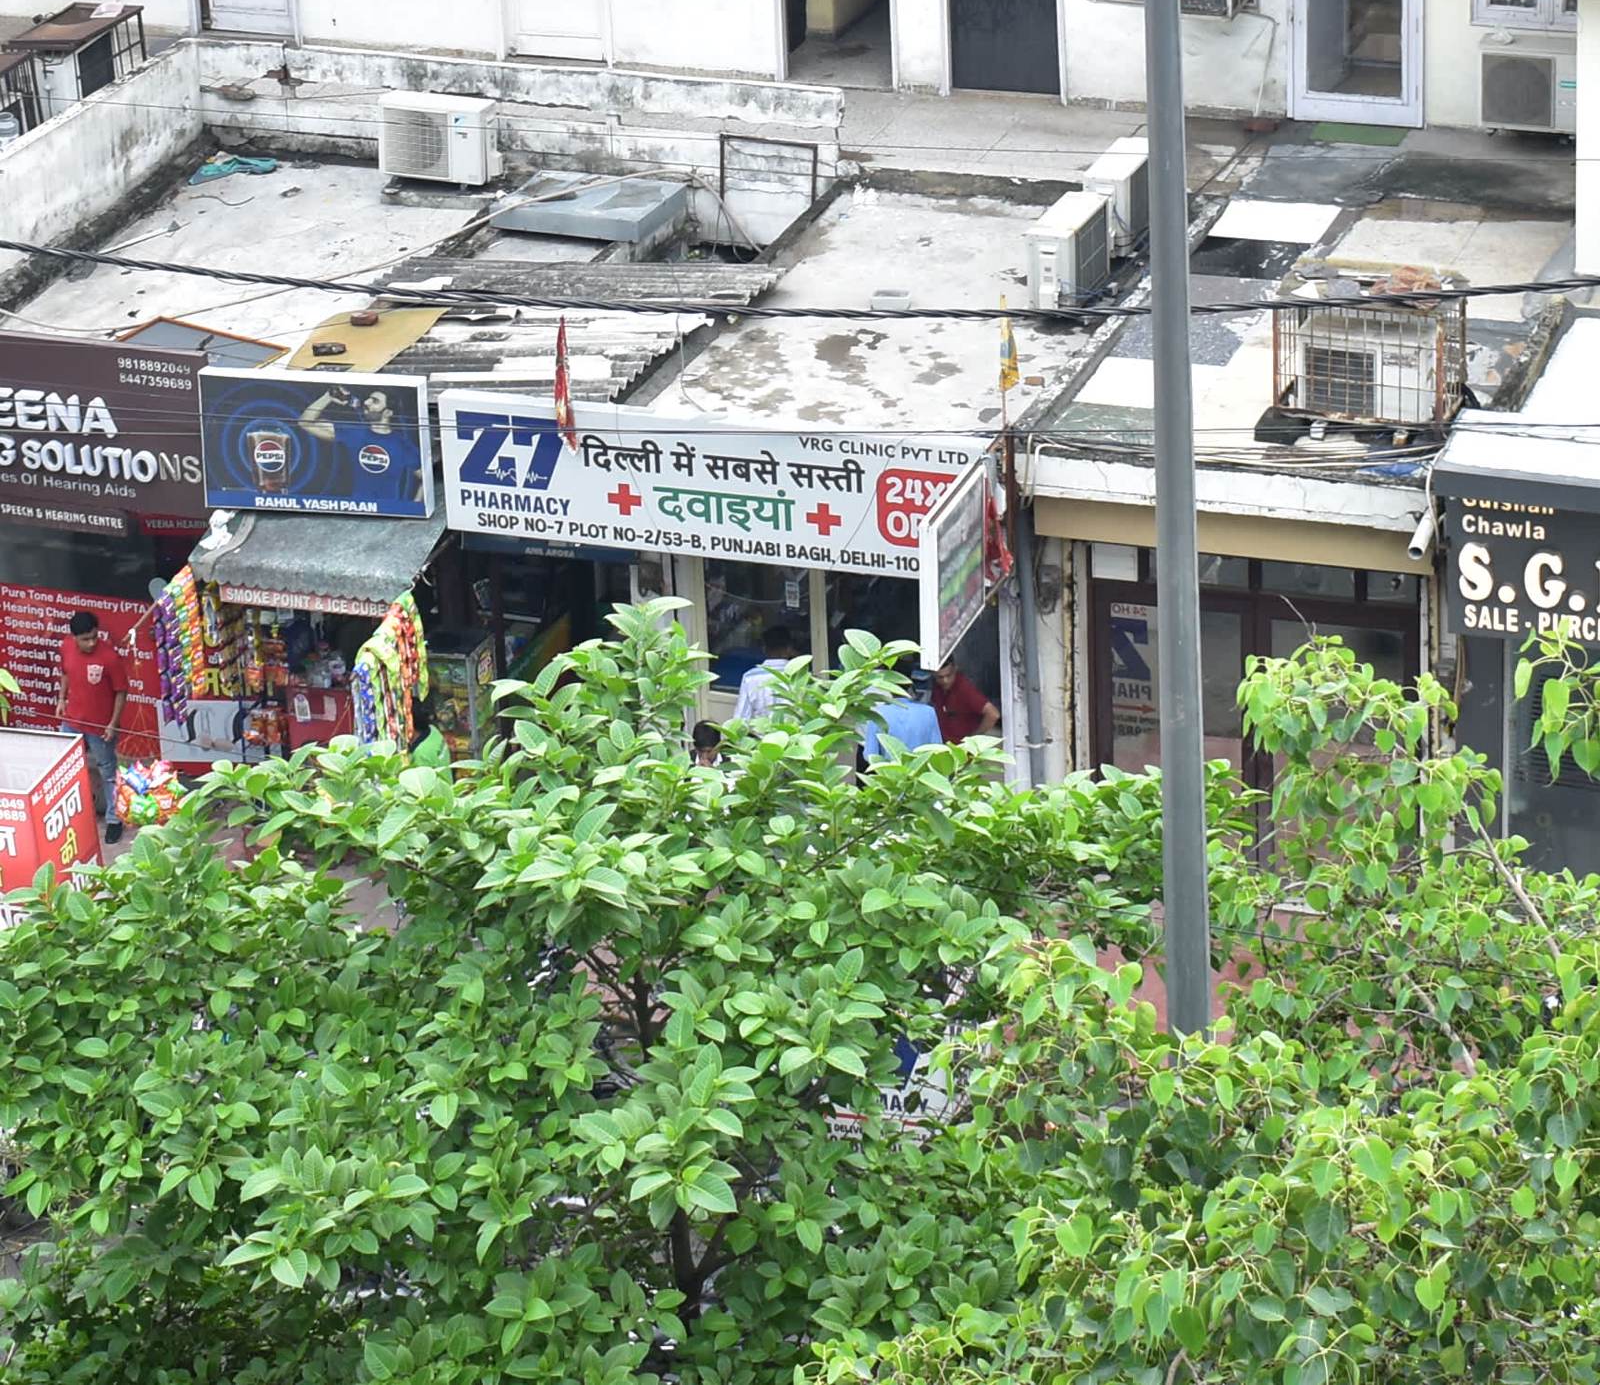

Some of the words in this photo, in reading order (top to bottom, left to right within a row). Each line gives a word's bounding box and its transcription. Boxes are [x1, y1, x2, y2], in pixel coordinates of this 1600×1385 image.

[117, 357, 191, 375] 9818892049
[119, 372, 193, 391] 8447359689
[20, 438, 202, 484] SOLUTIONS
[256, 452, 284, 460] PEPSI
[580, 434, 663, 474] दिल्ली
[669, 442, 696, 478] में
[702, 449, 781, 486] सबसे
[787, 456, 865, 494] सस्ती
[799, 436, 834, 453] VRG
[838, 439, 897, 459] CLINIC
[901, 446, 933, 462] PVT
[938, 449, 970, 466] LTD
[21, 473, 38, 486] Of
[43, 476, 101, 496] Hearing
[104, 482, 137, 498] Aids
[885, 476, 951, 507] 24X
[255, 496, 300, 509] RAHUL
[302, 498, 339, 511] YASH
[340, 500, 378, 513] PAAN
[460, 488, 571, 517] PHARMACY
[652, 486, 797, 533] दवाइयां
[0, 503, 34, 518] SPEECH
[45, 508, 87, 525] HEARING
[88, 512, 124, 530] CENTRE
[1462, 513, 1546, 541] Chawla
[477, 512, 520, 531] SHOP
[524, 516, 563, 535] NO-7
[569, 521, 608, 541] PLOT
[711, 537, 781, 558] PUNJABI
[1459, 541, 1600, 613] S.G.
[1, 585, 27, 599] Pure
[28, 588, 54, 603] Tone
[56, 593, 119, 613] Audiometry
[2, 601, 44, 618] Hearing
[226, 587, 270, 605] SMOKE
[272, 592, 311, 609] POINT
[315, 597, 324, 611] &
[326, 598, 348, 613] ICE
[4, 616, 44, 631] Speech
[1464, 603, 1520, 633] SALE
[7, 645, 47, 660] Special
[9, 661, 51, 678] Hearing
